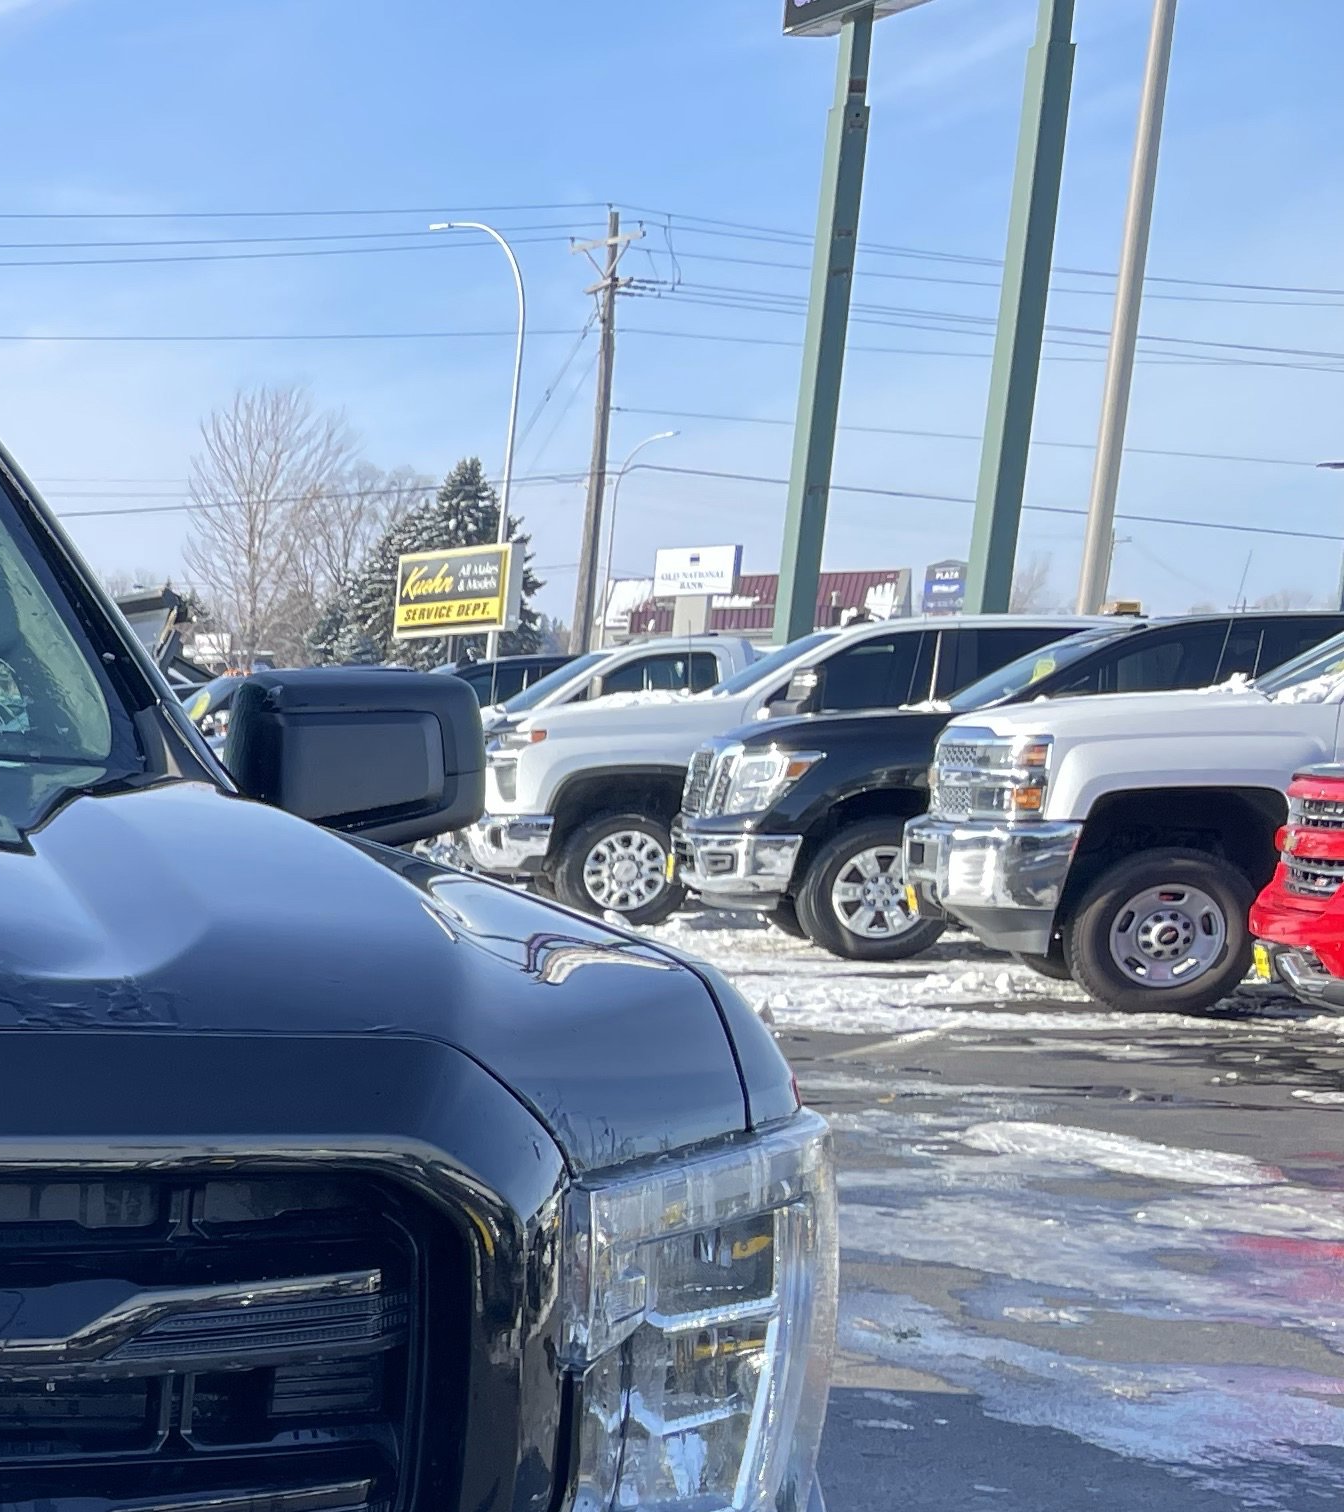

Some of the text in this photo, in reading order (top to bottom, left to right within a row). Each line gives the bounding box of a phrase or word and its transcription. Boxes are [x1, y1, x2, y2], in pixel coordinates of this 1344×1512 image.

[401, 562, 454, 600] Kuehn
[404, 602, 490, 622] SERVICE DEPT.
